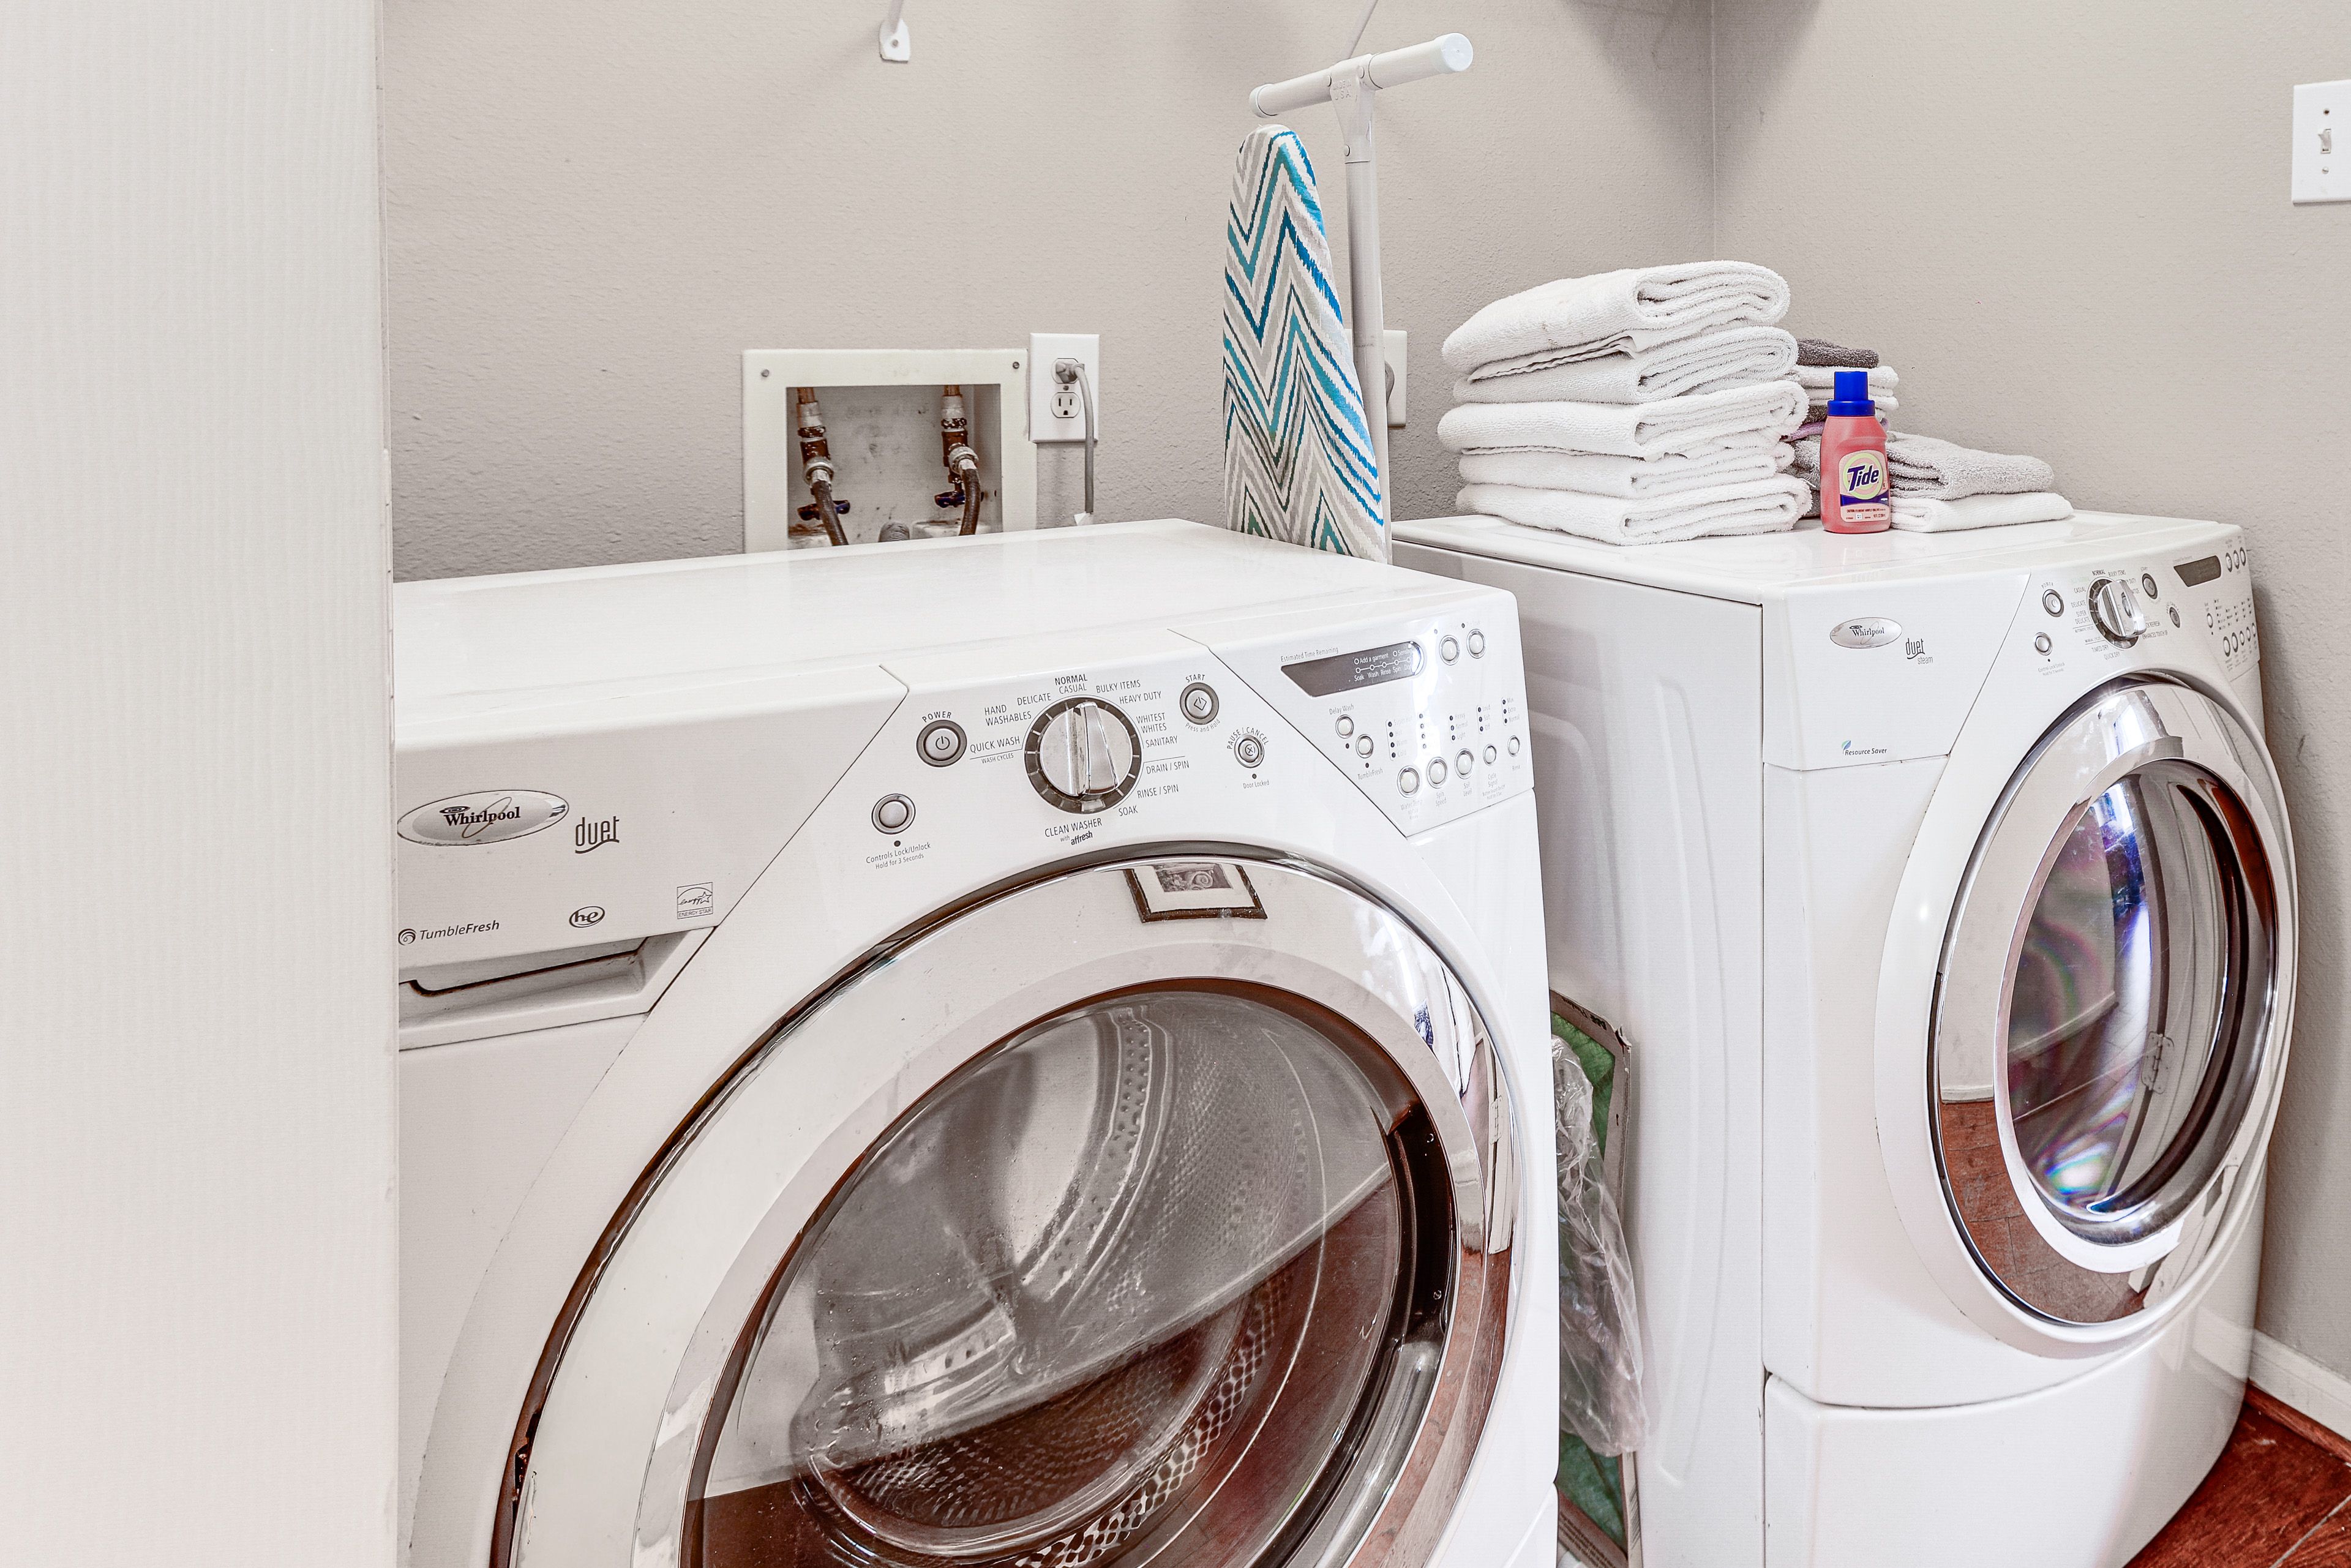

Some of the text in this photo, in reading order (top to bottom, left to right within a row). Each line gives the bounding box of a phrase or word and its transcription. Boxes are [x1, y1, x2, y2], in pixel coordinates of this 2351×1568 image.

[1847, 465, 1879, 492] Tide
[1851, 627, 1885, 637] Whirlpool
[1281, 653, 1304, 662] Estimated
[1316, 647, 1339, 657] Remaining
[1905, 638, 1925, 659] duet
[1372, 653, 1389, 663] garment
[1918, 656, 1933, 664] steam
[1054, 673, 1088, 686] NORMAL
[1185, 673, 1205, 683] START
[1059, 683, 1087, 694] CASUAL
[1096, 679, 1141, 694] BULKY ITEMS
[1017, 692, 1051, 706] DELICATE
[1119, 691, 1162, 705] HEAVY DUTY
[922, 711, 952, 723] POWER
[984, 704, 1007, 716] HAND
[1329, 707, 1342, 715] Delay
[985, 710, 1032, 726] WASHABLES
[1136, 712, 1166, 724] WHITEST
[1141, 722, 1168, 734] WHITES
[1185, 722, 1199, 732] Press
[1210, 719, 1221, 729] Hold
[970, 735, 1021, 754] QUICK WASH
[1146, 735, 1178, 748] SANITARY
[1226, 729, 1241, 749] PAUSE
[1246, 727, 1269, 745] CANCEL
[981, 752, 1014, 764] WASH CYCLES
[1146, 760, 1190, 775] DRAIN / SPIN
[1357, 767, 1384, 781] TumbleFresh
[1137, 784, 1179, 798] RINSE / SPIN
[443, 806, 520, 827] Whirlpool
[1118, 805, 1138, 817] SOAK
[575, 816, 620, 853] duet
[1044, 817, 1103, 838] CLEAN WASHER
[1071, 830, 1093, 846] affresh
[866, 842, 931, 864] Controls Lock/Unlock
[903, 853, 924, 863] Seconds
[574, 910, 599, 924] he
[420, 920, 500, 940] TumbleFresh
